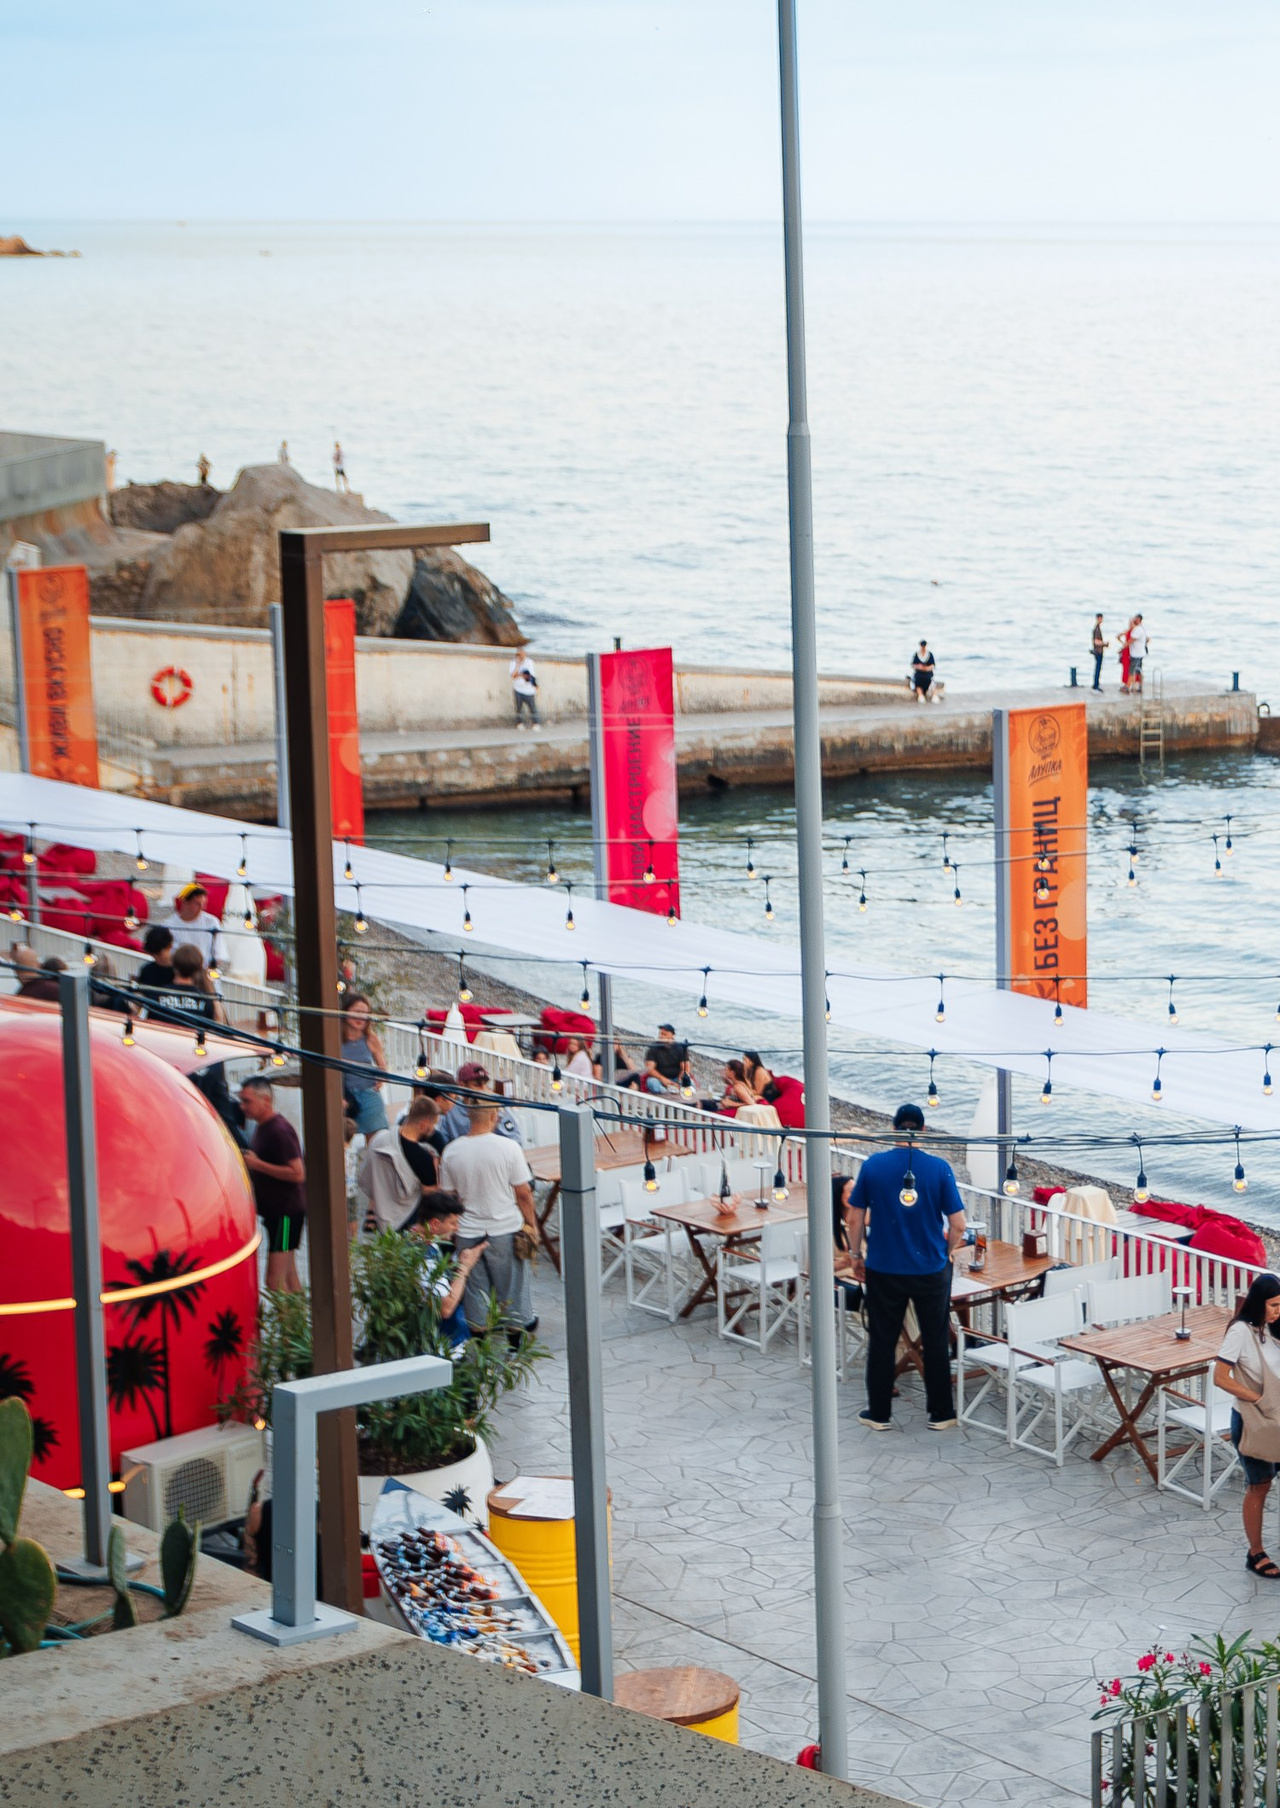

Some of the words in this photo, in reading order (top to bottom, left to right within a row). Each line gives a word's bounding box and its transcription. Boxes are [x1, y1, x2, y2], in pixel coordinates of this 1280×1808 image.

[627, 716, 644, 836] НАСТРОЕНИЕ
[1032, 796, 1061, 910] ГРАНИЦ
[1033, 916, 1059, 971] БЕЗ
